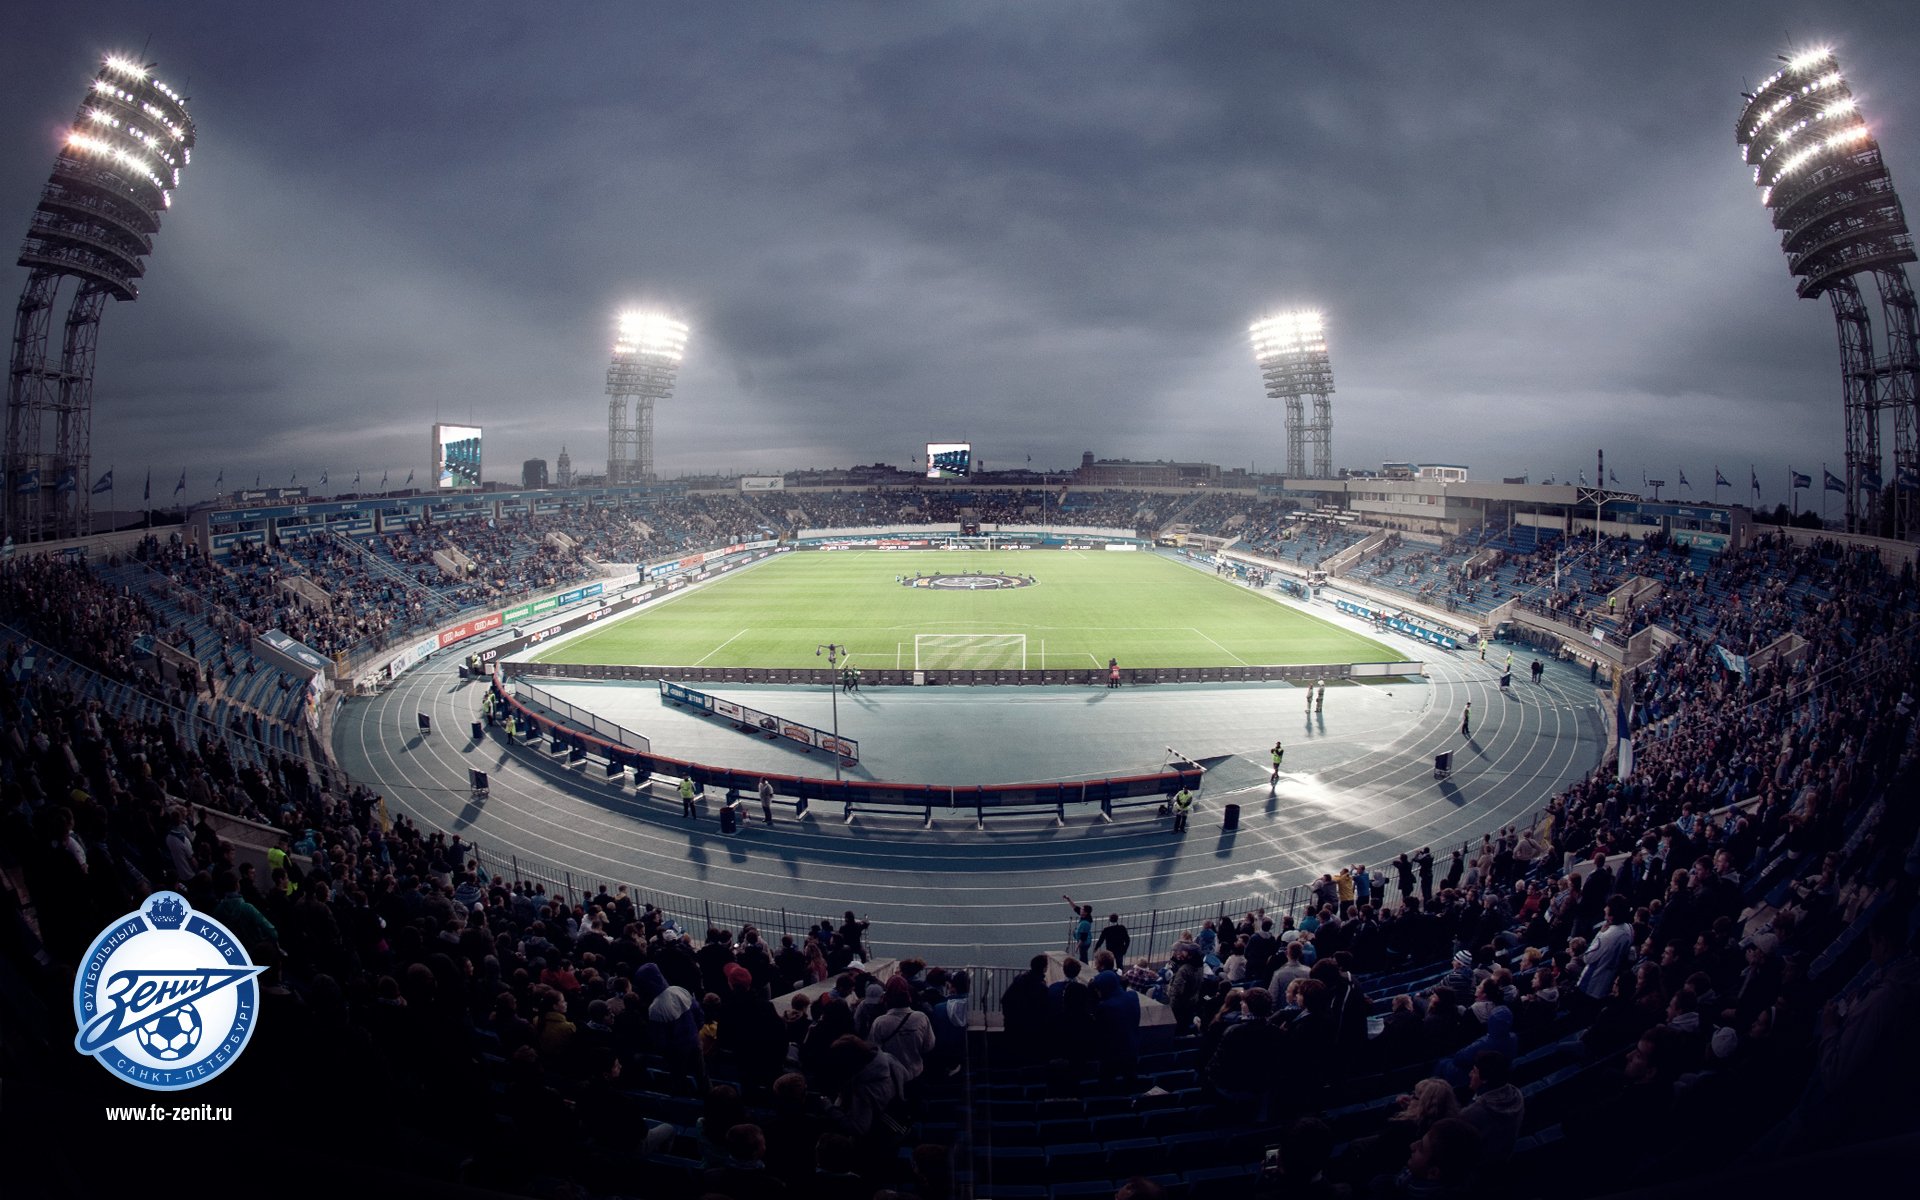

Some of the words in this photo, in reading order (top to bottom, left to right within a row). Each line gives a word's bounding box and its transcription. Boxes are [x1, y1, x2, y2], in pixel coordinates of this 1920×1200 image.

[487, 618, 499, 627] Audi
[454, 628, 466, 638] Audi
[550, 626, 562, 635] LED
[482, 650, 497, 661] LED
